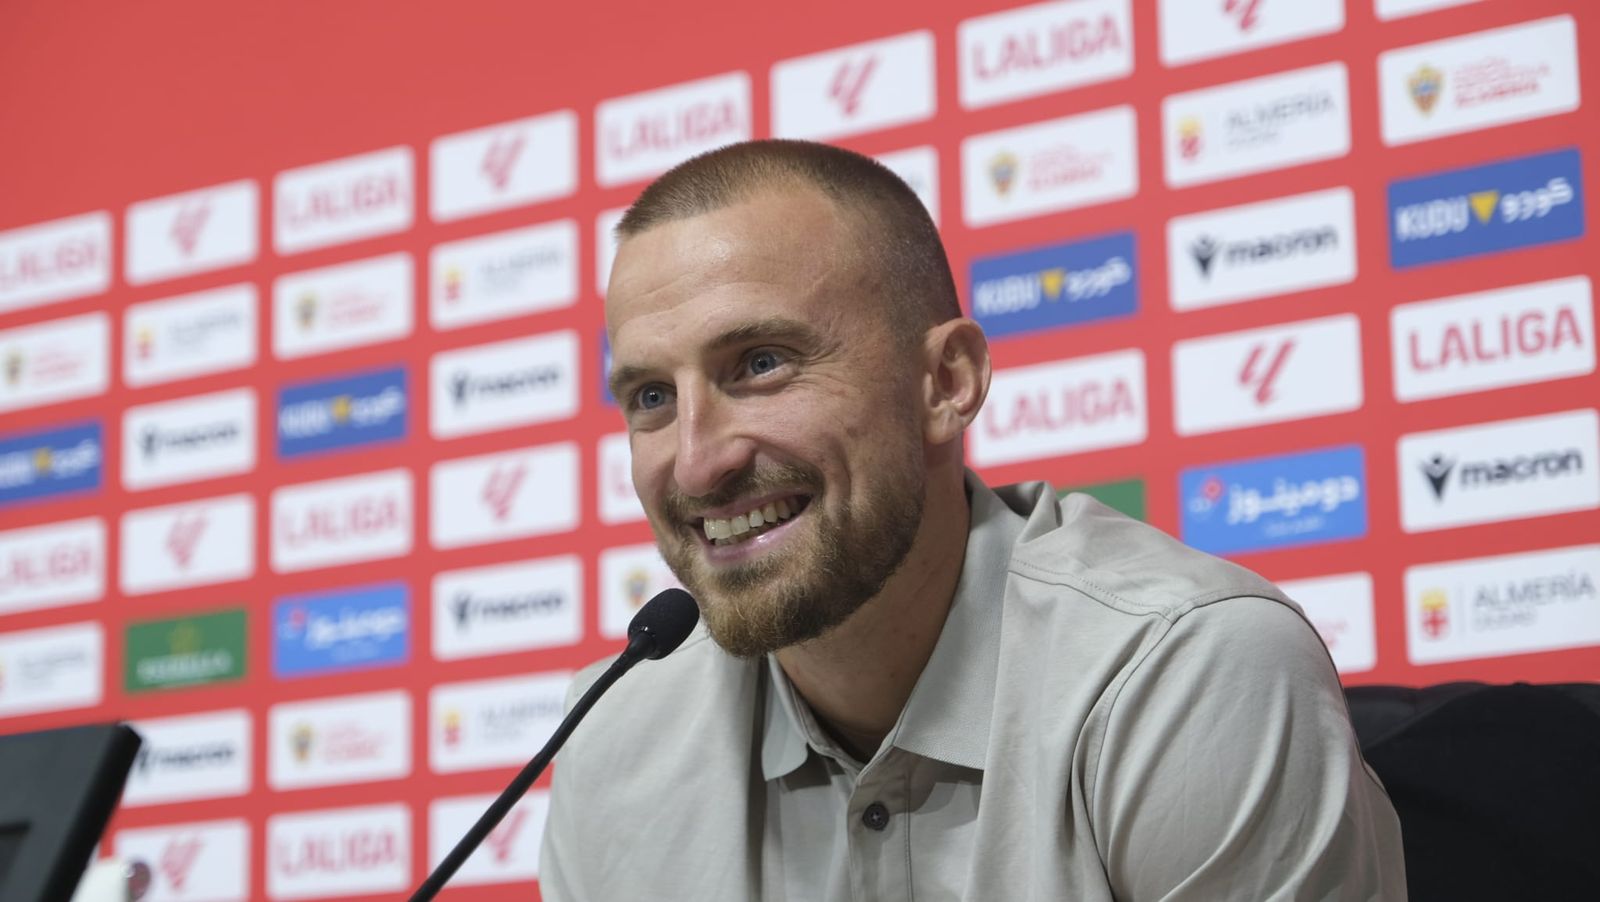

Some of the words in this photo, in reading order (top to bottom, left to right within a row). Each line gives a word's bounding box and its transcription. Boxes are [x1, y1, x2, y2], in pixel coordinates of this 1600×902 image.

[974, 15, 1121, 79] LALIGA
[1395, 196, 1470, 242] KUDU
[1226, 227, 1338, 265] macron
[1409, 307, 1583, 373] LALIGA
[985, 380, 1134, 438] LALIGA
[1461, 449, 1582, 487] macron
[1473, 571, 1595, 607] ALMERÍA
[277, 830, 396, 874] LALIGA
